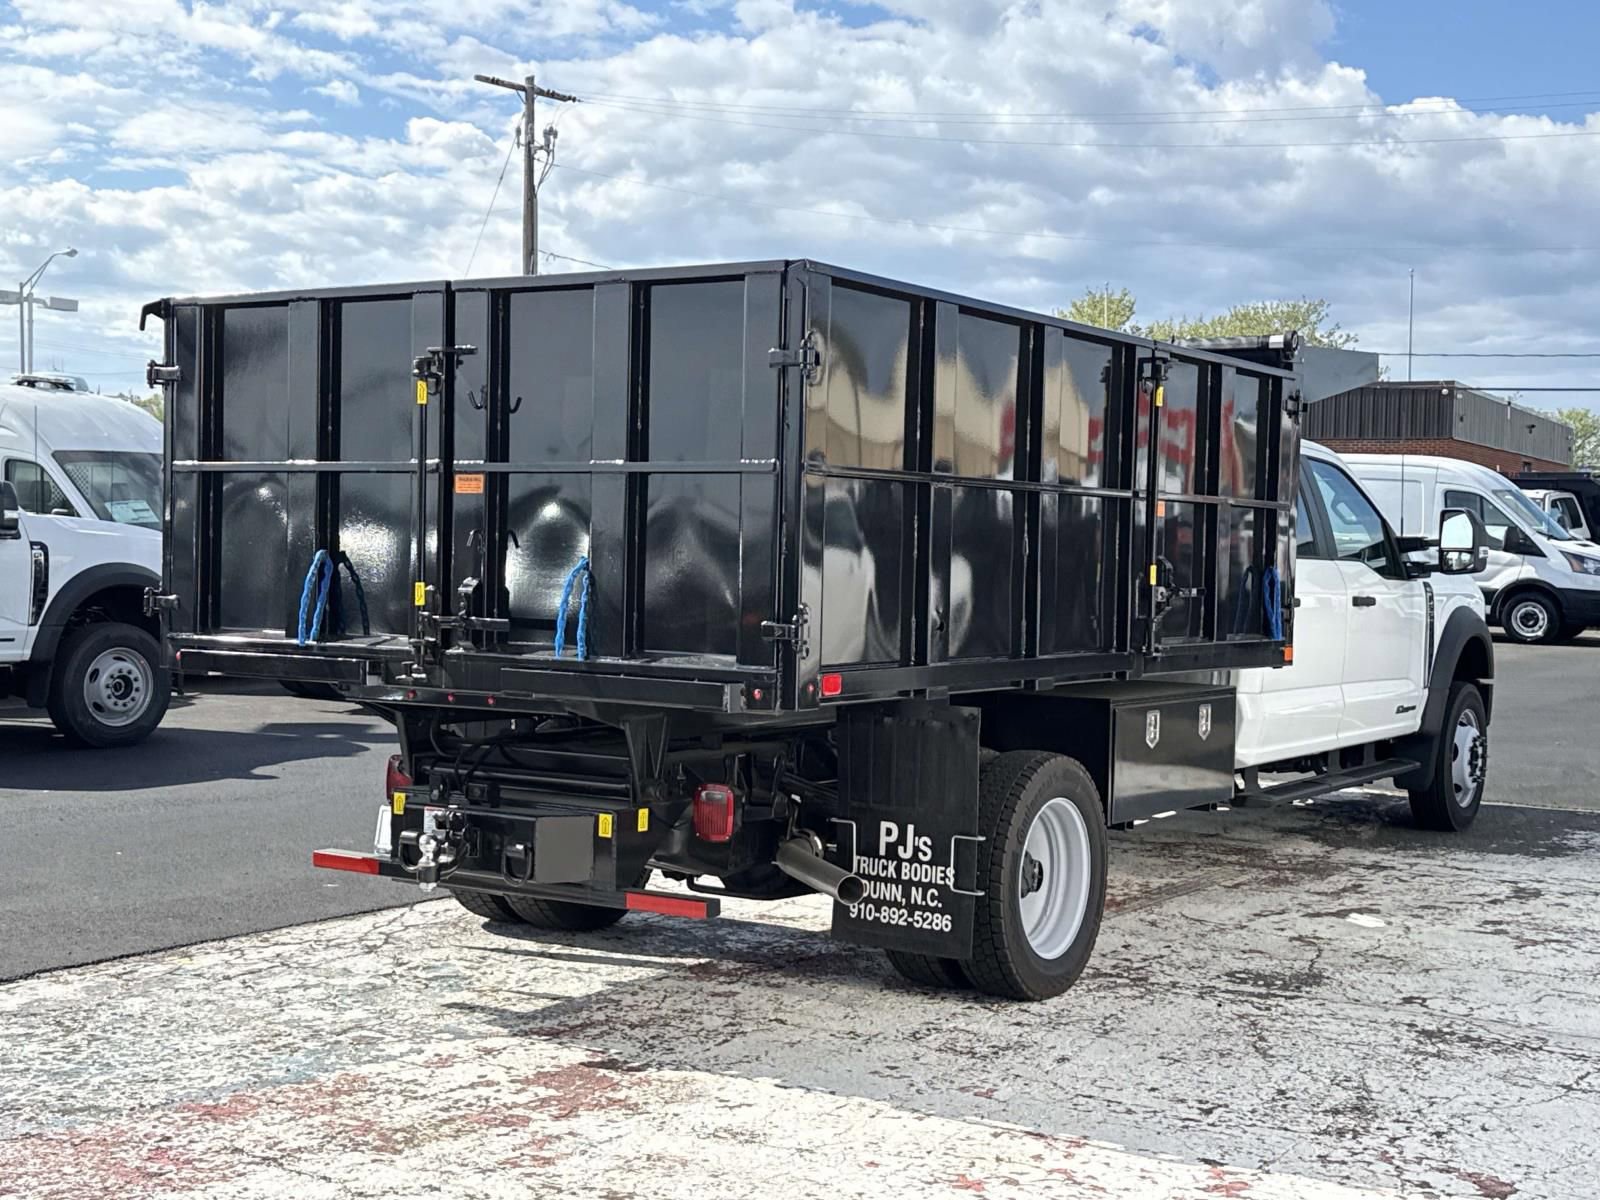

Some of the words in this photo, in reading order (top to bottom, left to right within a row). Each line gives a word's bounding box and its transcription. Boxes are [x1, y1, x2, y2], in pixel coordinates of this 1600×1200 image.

[879, 820, 932, 861] PJ's
[855, 855, 897, 879] TRUCK
[901, 861, 955, 886] BODIES
[863, 879, 906, 906] DUNN,
[910, 886, 943, 908] N.C.
[849, 902, 952, 932] 910-892-5286
